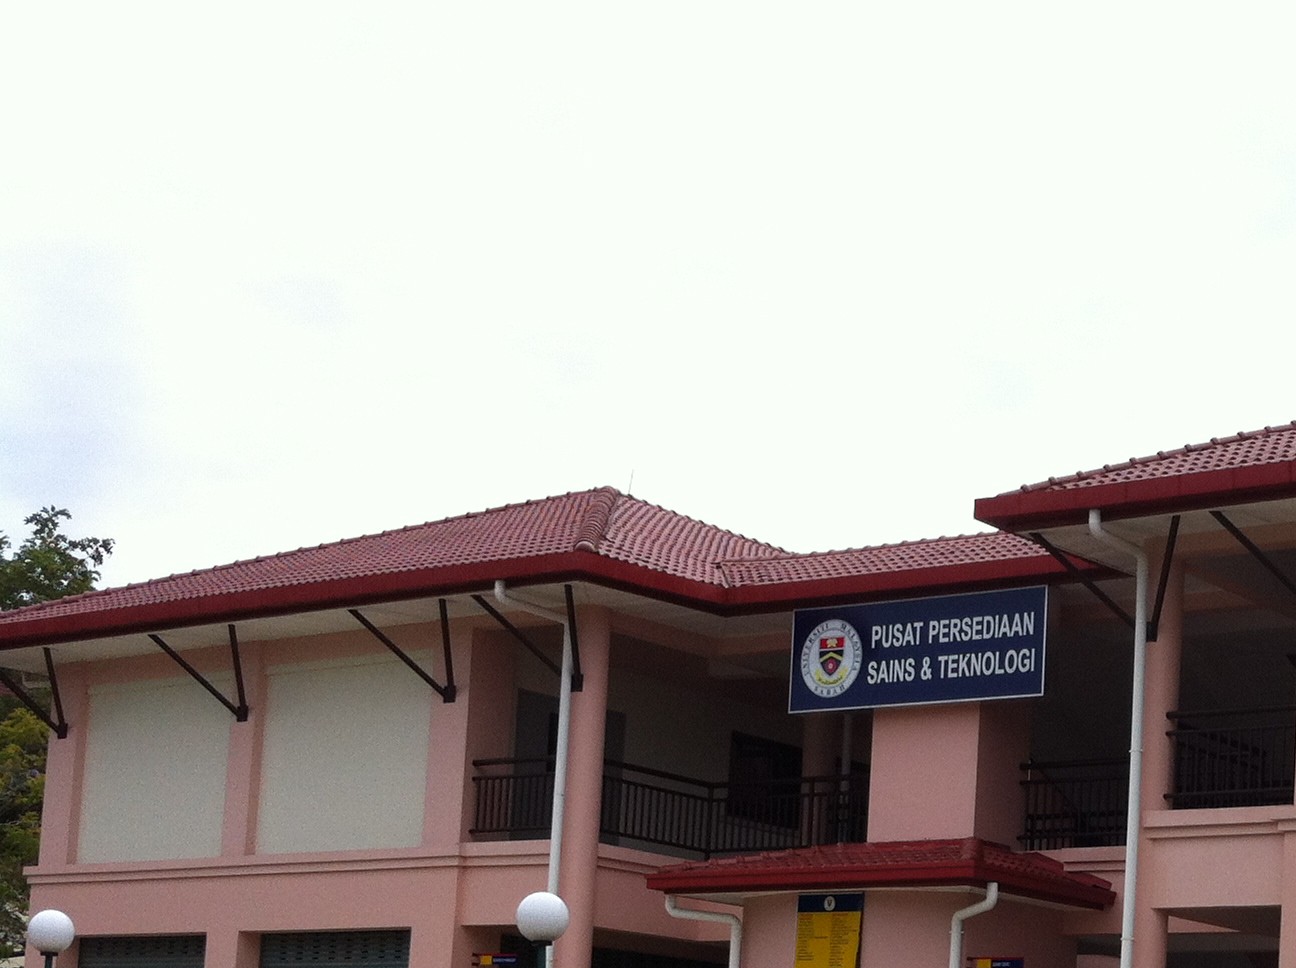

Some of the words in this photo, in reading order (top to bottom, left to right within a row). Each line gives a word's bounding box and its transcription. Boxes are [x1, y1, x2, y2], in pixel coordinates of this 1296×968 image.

[871, 622, 924, 649] PUSAT
[928, 612, 1035, 644] PERSEDIAAN
[867, 658, 916, 685] SAINS
[920, 656, 932, 681] &
[938, 648, 1035, 679] TEKNOLOGI
